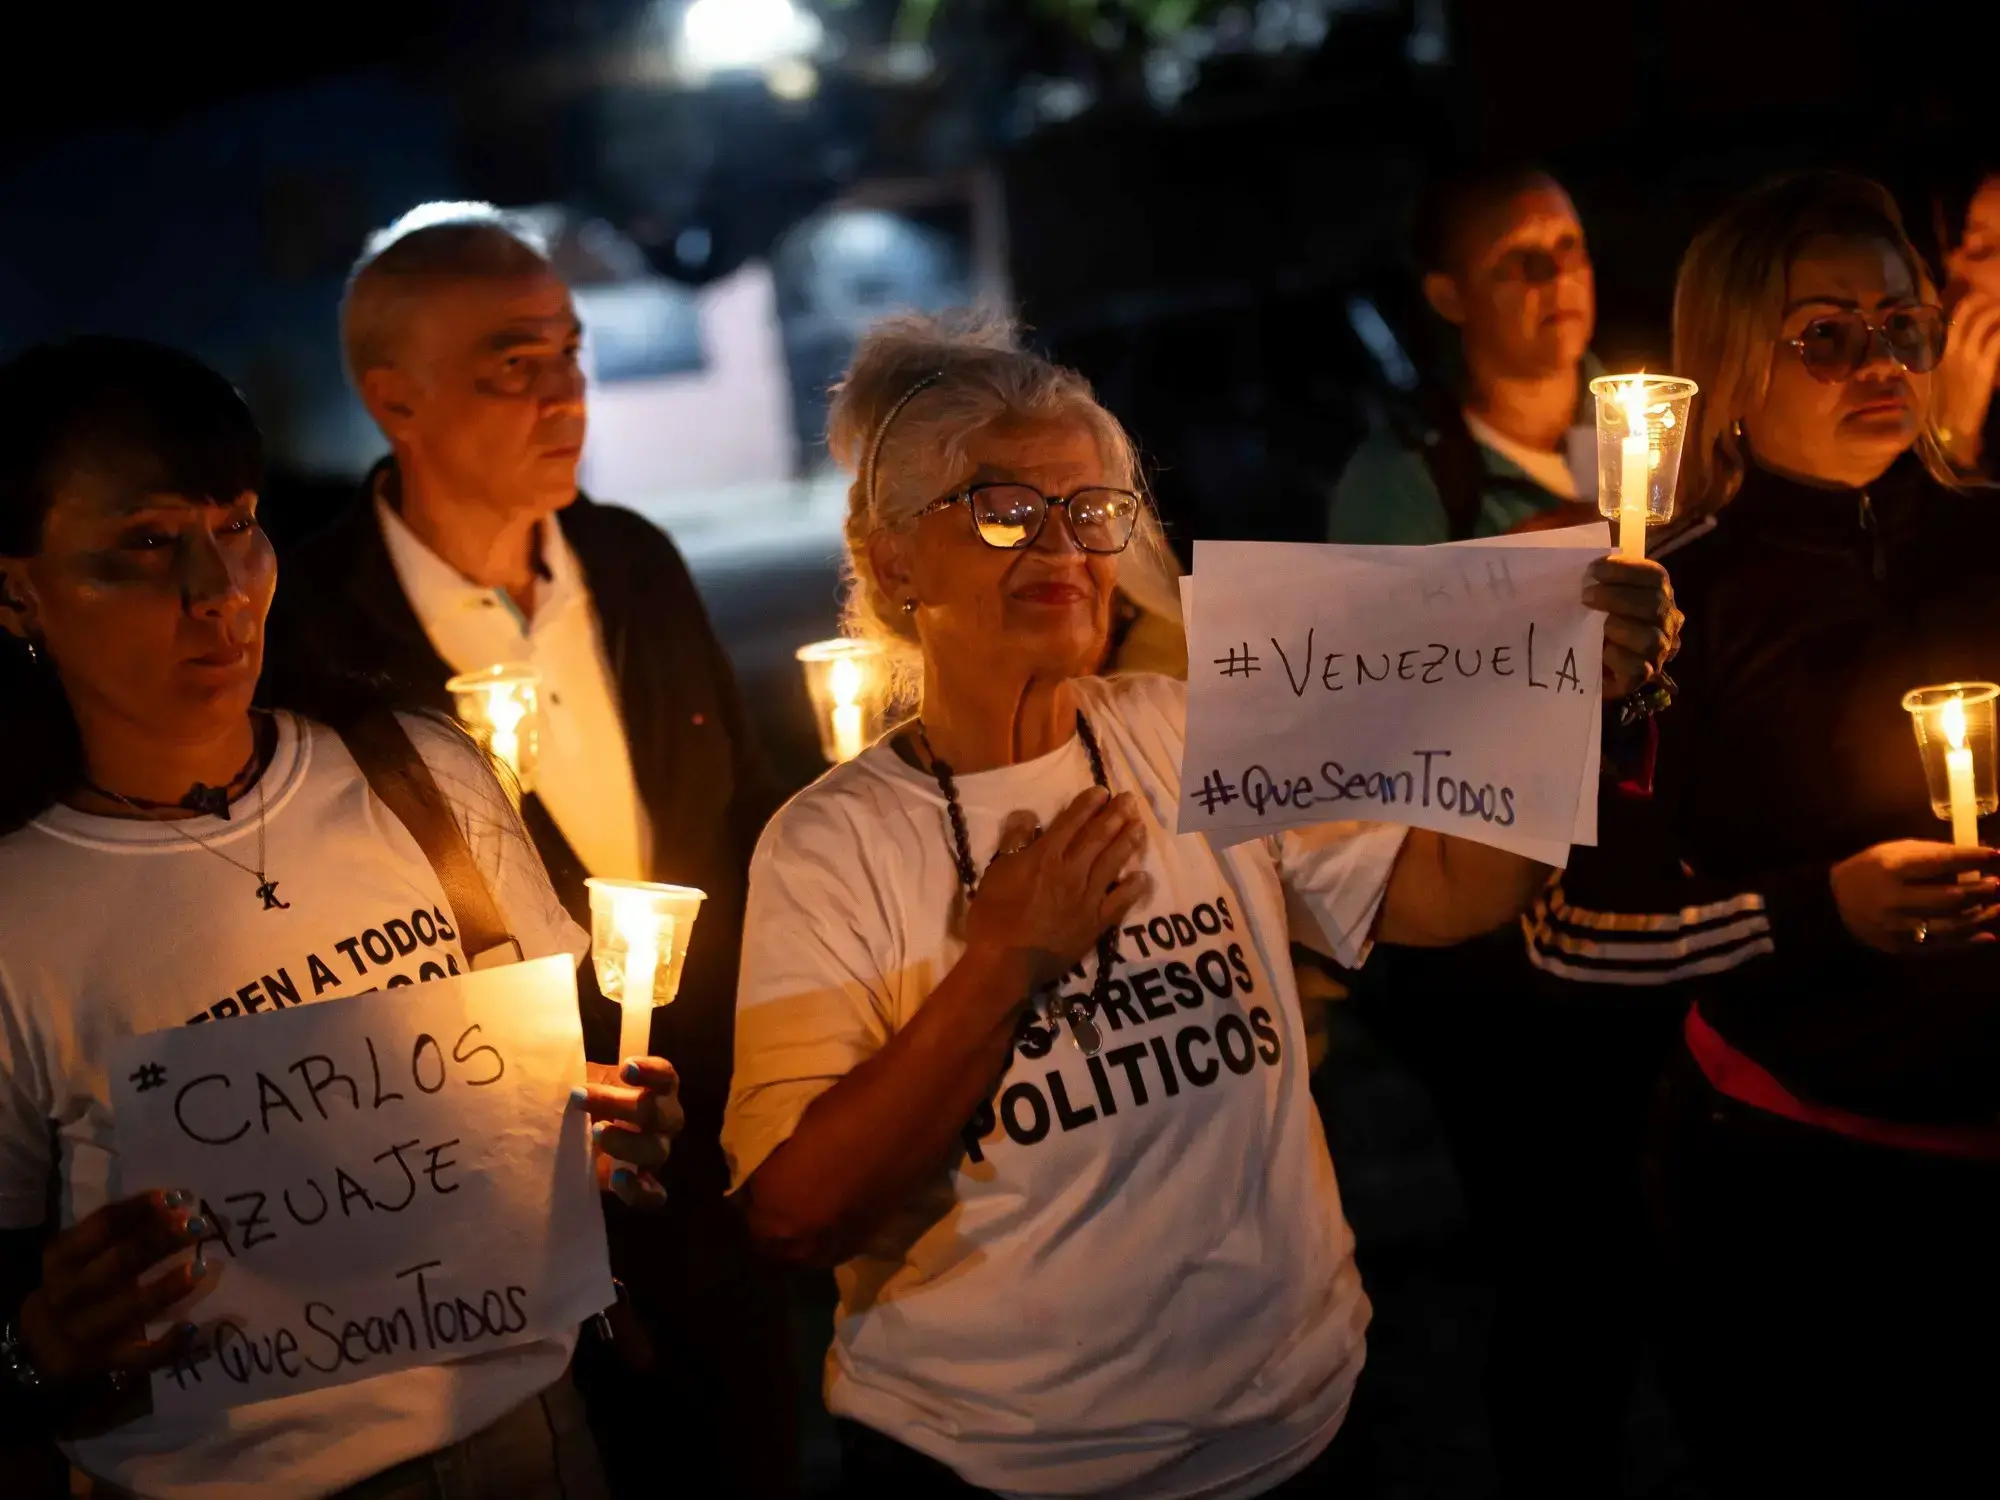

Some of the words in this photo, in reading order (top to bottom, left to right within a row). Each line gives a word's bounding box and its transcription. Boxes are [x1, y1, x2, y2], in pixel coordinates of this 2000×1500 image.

[306, 953, 341, 995] A
[334, 904, 457, 976] TODOS
[1123, 897, 1235, 958] TODOS
[129, 1024, 504, 1145] #CARLOS
[196, 1138, 460, 1259] AZUAJE
